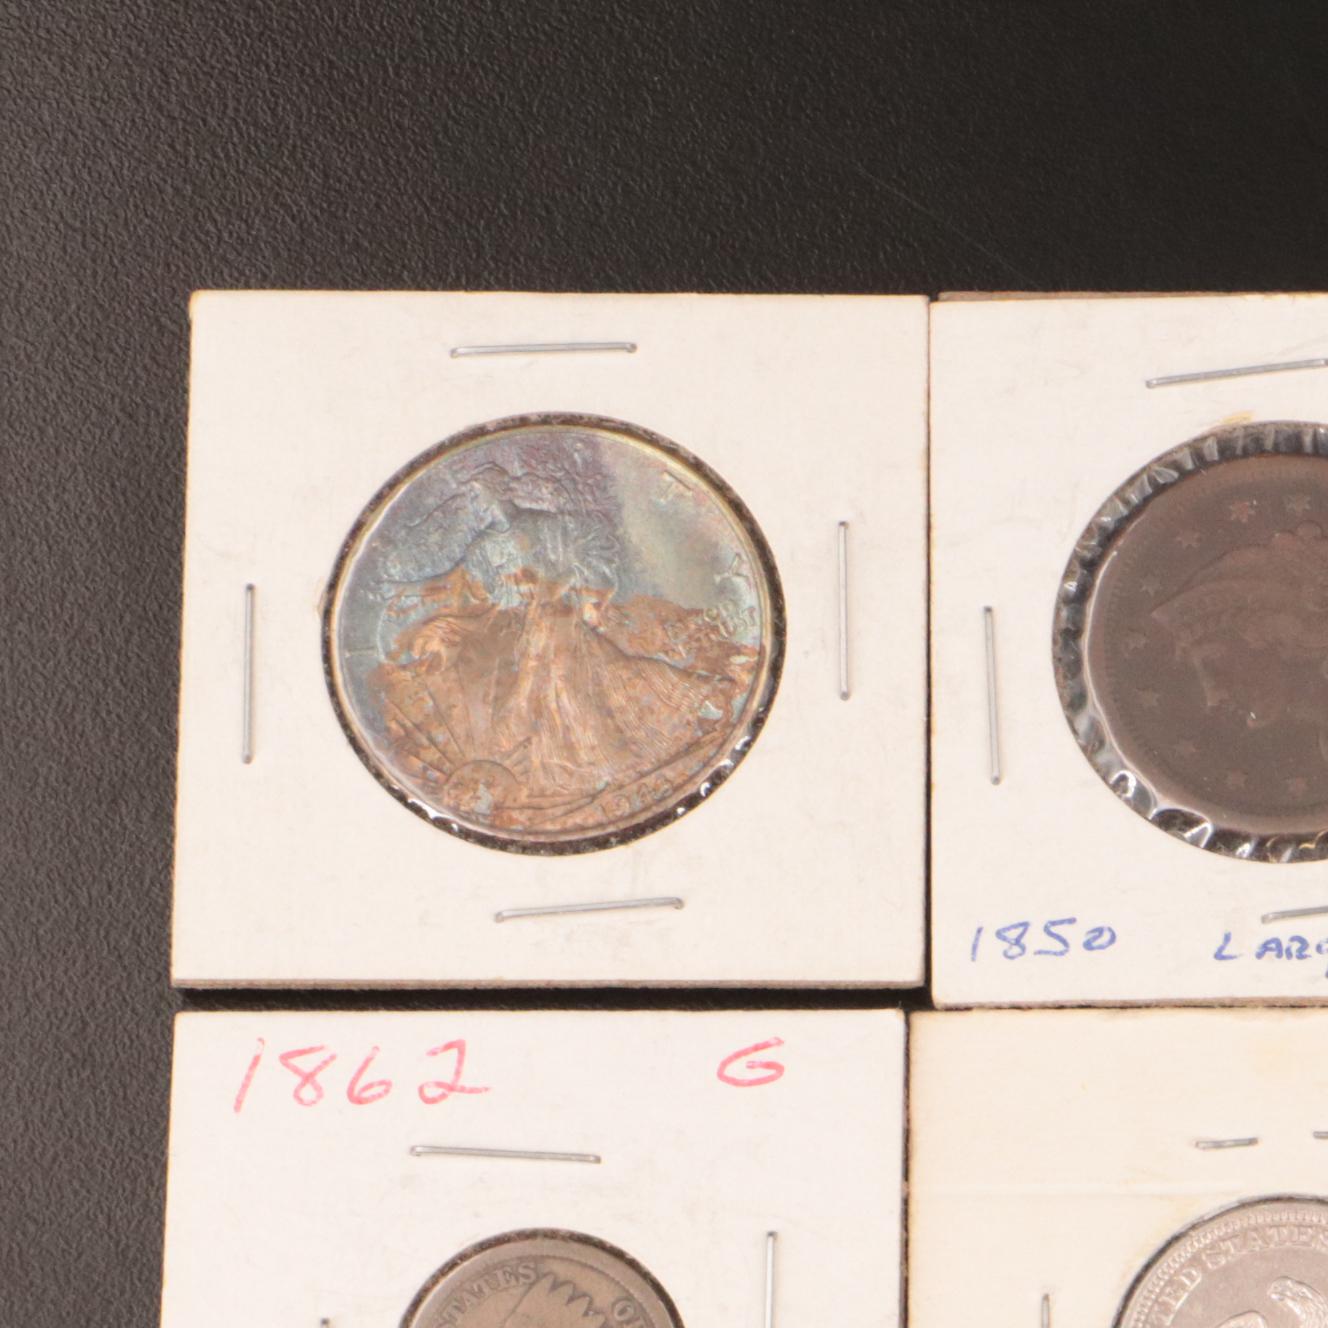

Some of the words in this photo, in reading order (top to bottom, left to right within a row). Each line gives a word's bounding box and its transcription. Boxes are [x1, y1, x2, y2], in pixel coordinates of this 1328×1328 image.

[971, 917, 1117, 962] 1850
[233, 1038, 492, 1113] 1862
[717, 1036, 786, 1088] G
